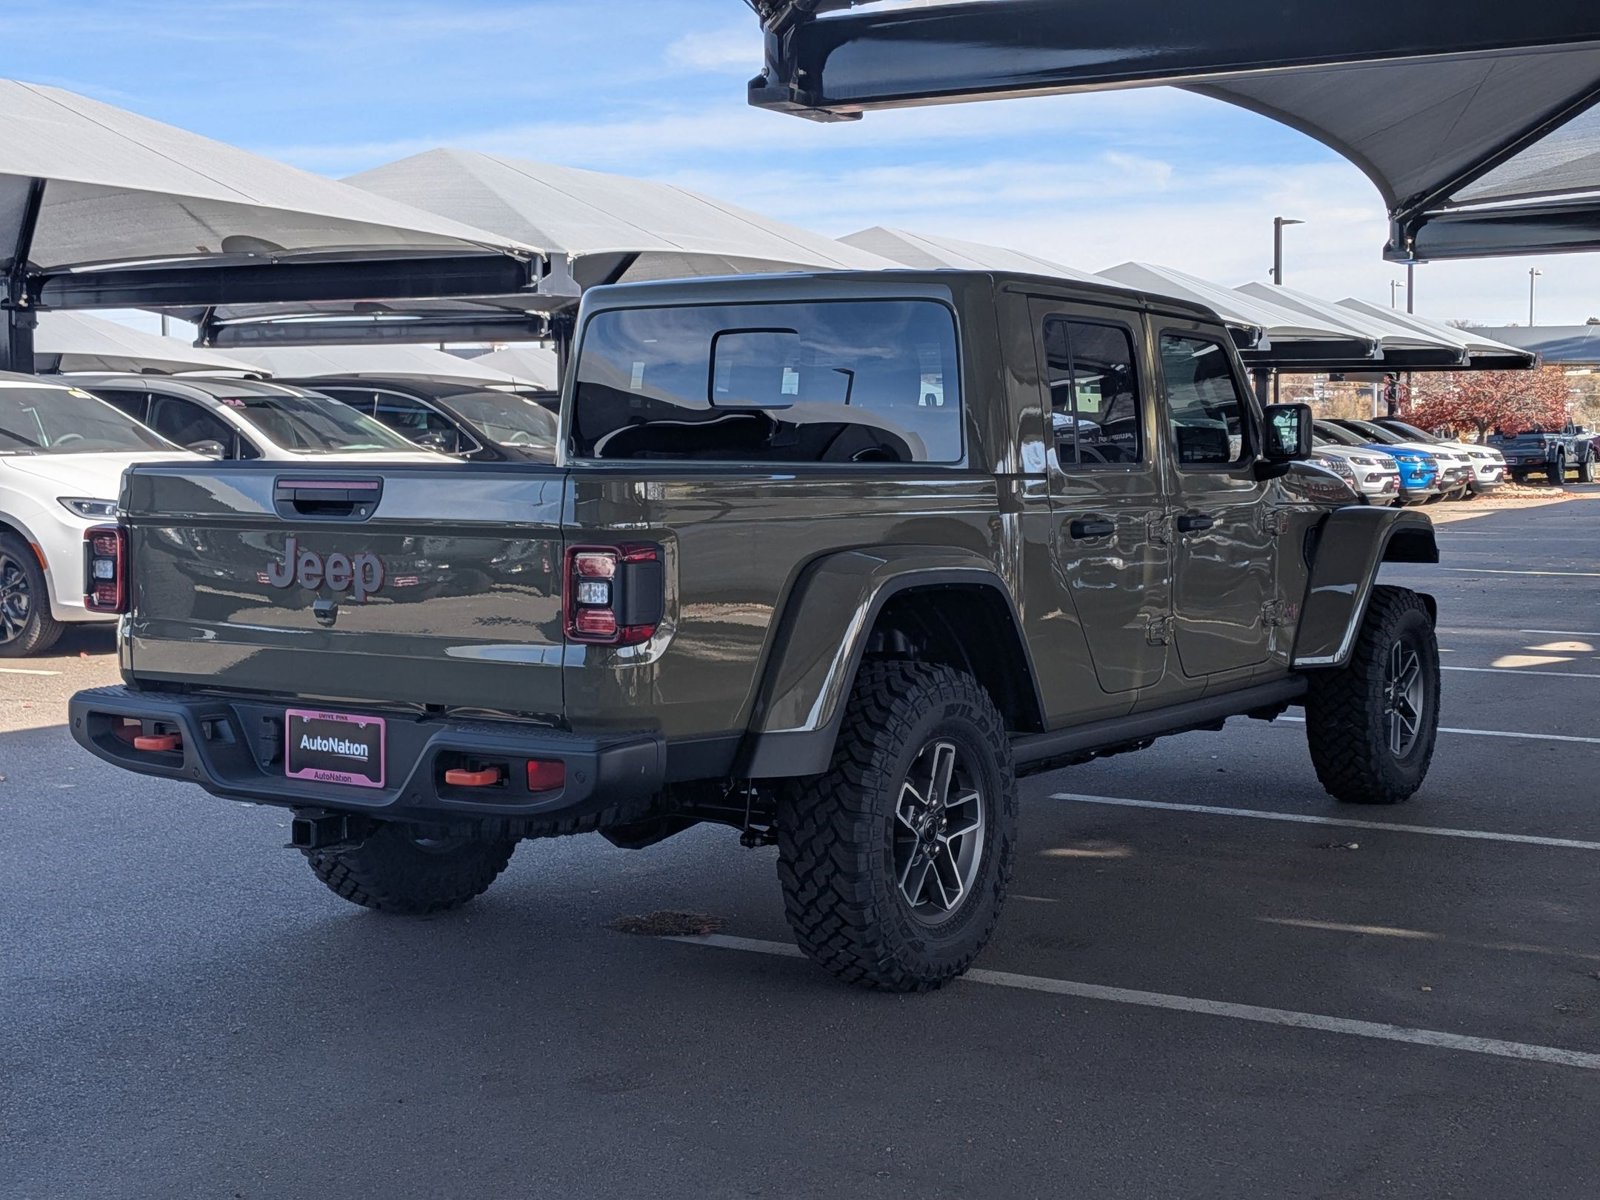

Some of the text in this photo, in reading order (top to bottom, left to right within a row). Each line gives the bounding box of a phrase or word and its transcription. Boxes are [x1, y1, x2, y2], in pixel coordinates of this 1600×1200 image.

[267, 537, 386, 602] Jeep
[300, 734, 369, 757] AutoNation
[314, 771, 352, 783] AutoNation
